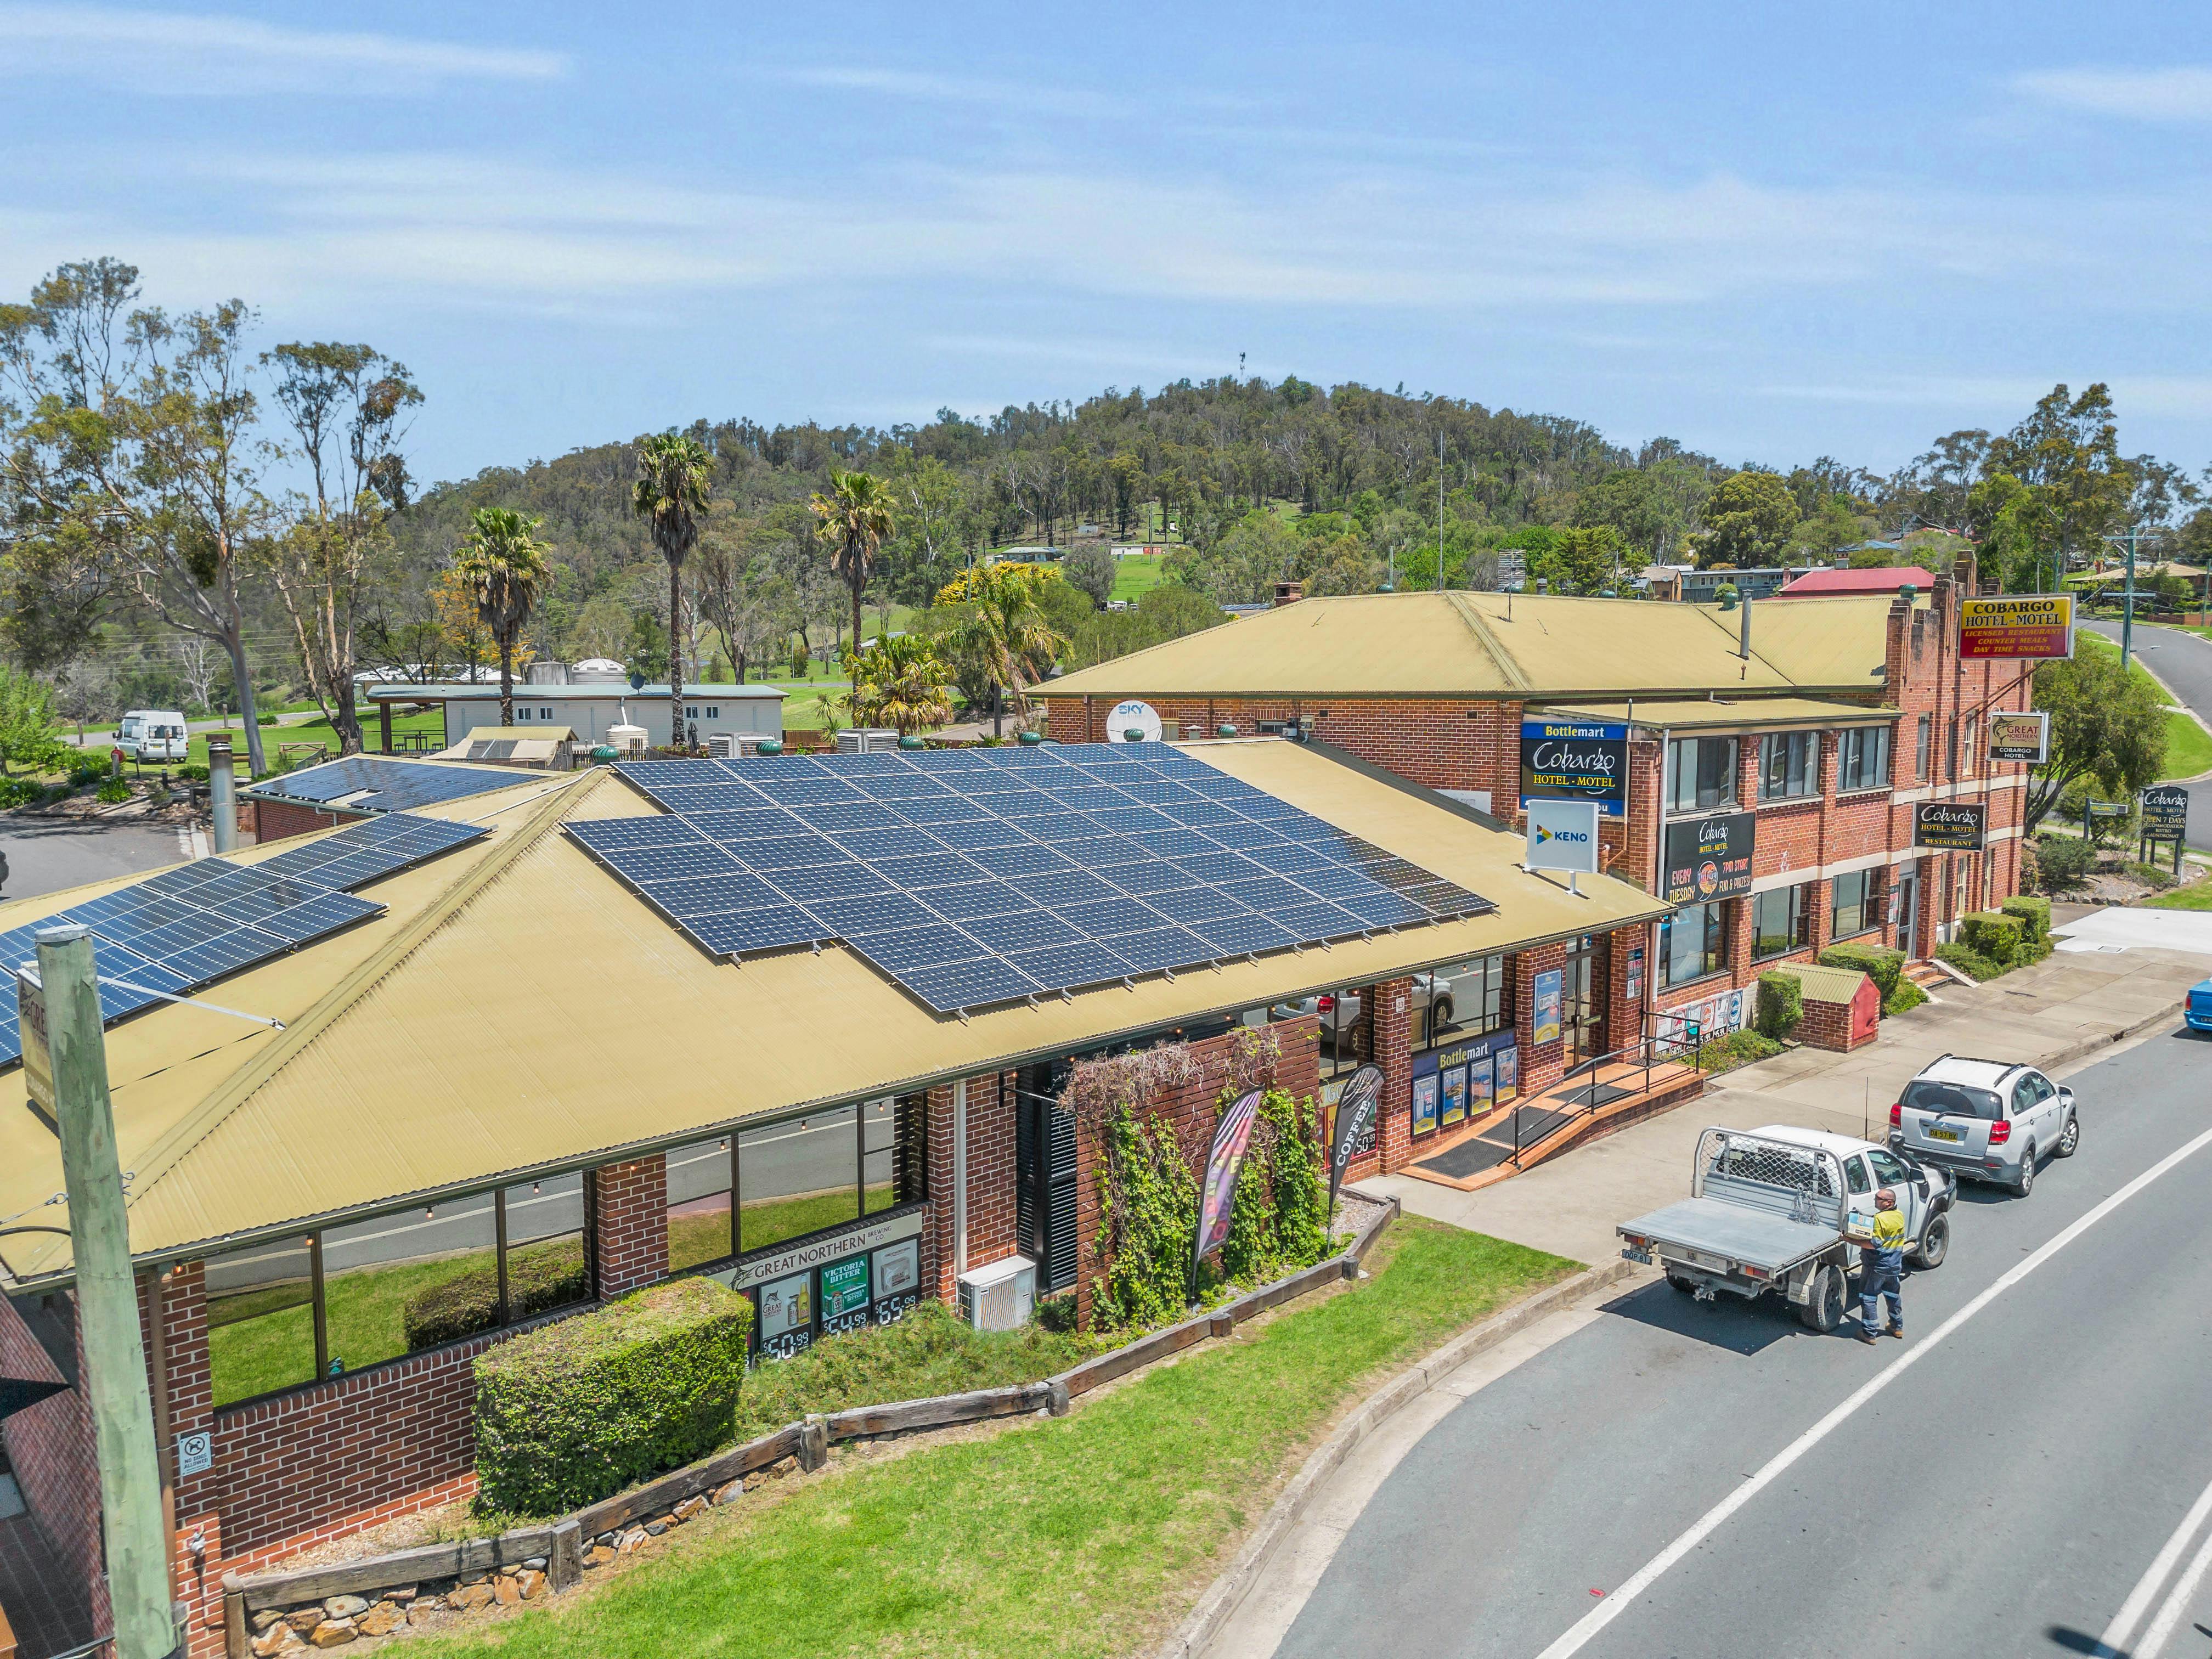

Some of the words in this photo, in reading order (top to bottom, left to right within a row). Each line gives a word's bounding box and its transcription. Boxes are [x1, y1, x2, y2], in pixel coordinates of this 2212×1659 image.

[1973, 601, 2055, 614] COBARGO
[1118, 704, 1146, 714] SKY
[1545, 725, 1605, 737] Bottlemart
[2006, 725, 2039, 734] GREAT
[1533, 742, 1615, 775] Cobargo
[1533, 775, 1570, 785] HOTEL
[1577, 776, 1616, 787] MOTEL
[2144, 791, 2186, 808] Cobargo
[1921, 805, 1978, 826] Cobargo
[1555, 831, 1588, 842] KENO
[1699, 822, 1729, 843] Cobargo
[1699, 845, 1712, 854] HOTEL
[1714, 843, 1728, 851] MOTEL
[1925, 838, 1973, 847] RESTAURANT
[1723, 861, 1734, 874] 7PM
[1734, 857, 1749, 872] START
[1672, 868, 1691, 886] EVERY
[1669, 885, 1696, 904] TUESDAY
[1719, 880, 1728, 893] FUN
[30, 1000, 48, 1037] GRE
[1440, 1042, 1488, 1068] Bottlemart
[1336, 1100, 1370, 1166] COFFEE
[867, 1226, 892, 1238] BREWING
[755, 1255, 797, 1278] GREAT
[799, 1234, 866, 1265] NORTHERN
[825, 1260, 865, 1278] VICTORIA
[830, 1268, 861, 1284] BITTER
[763, 1302, 782, 1313] GREAT
[184, 1458, 208, 1469] ALLOWED
